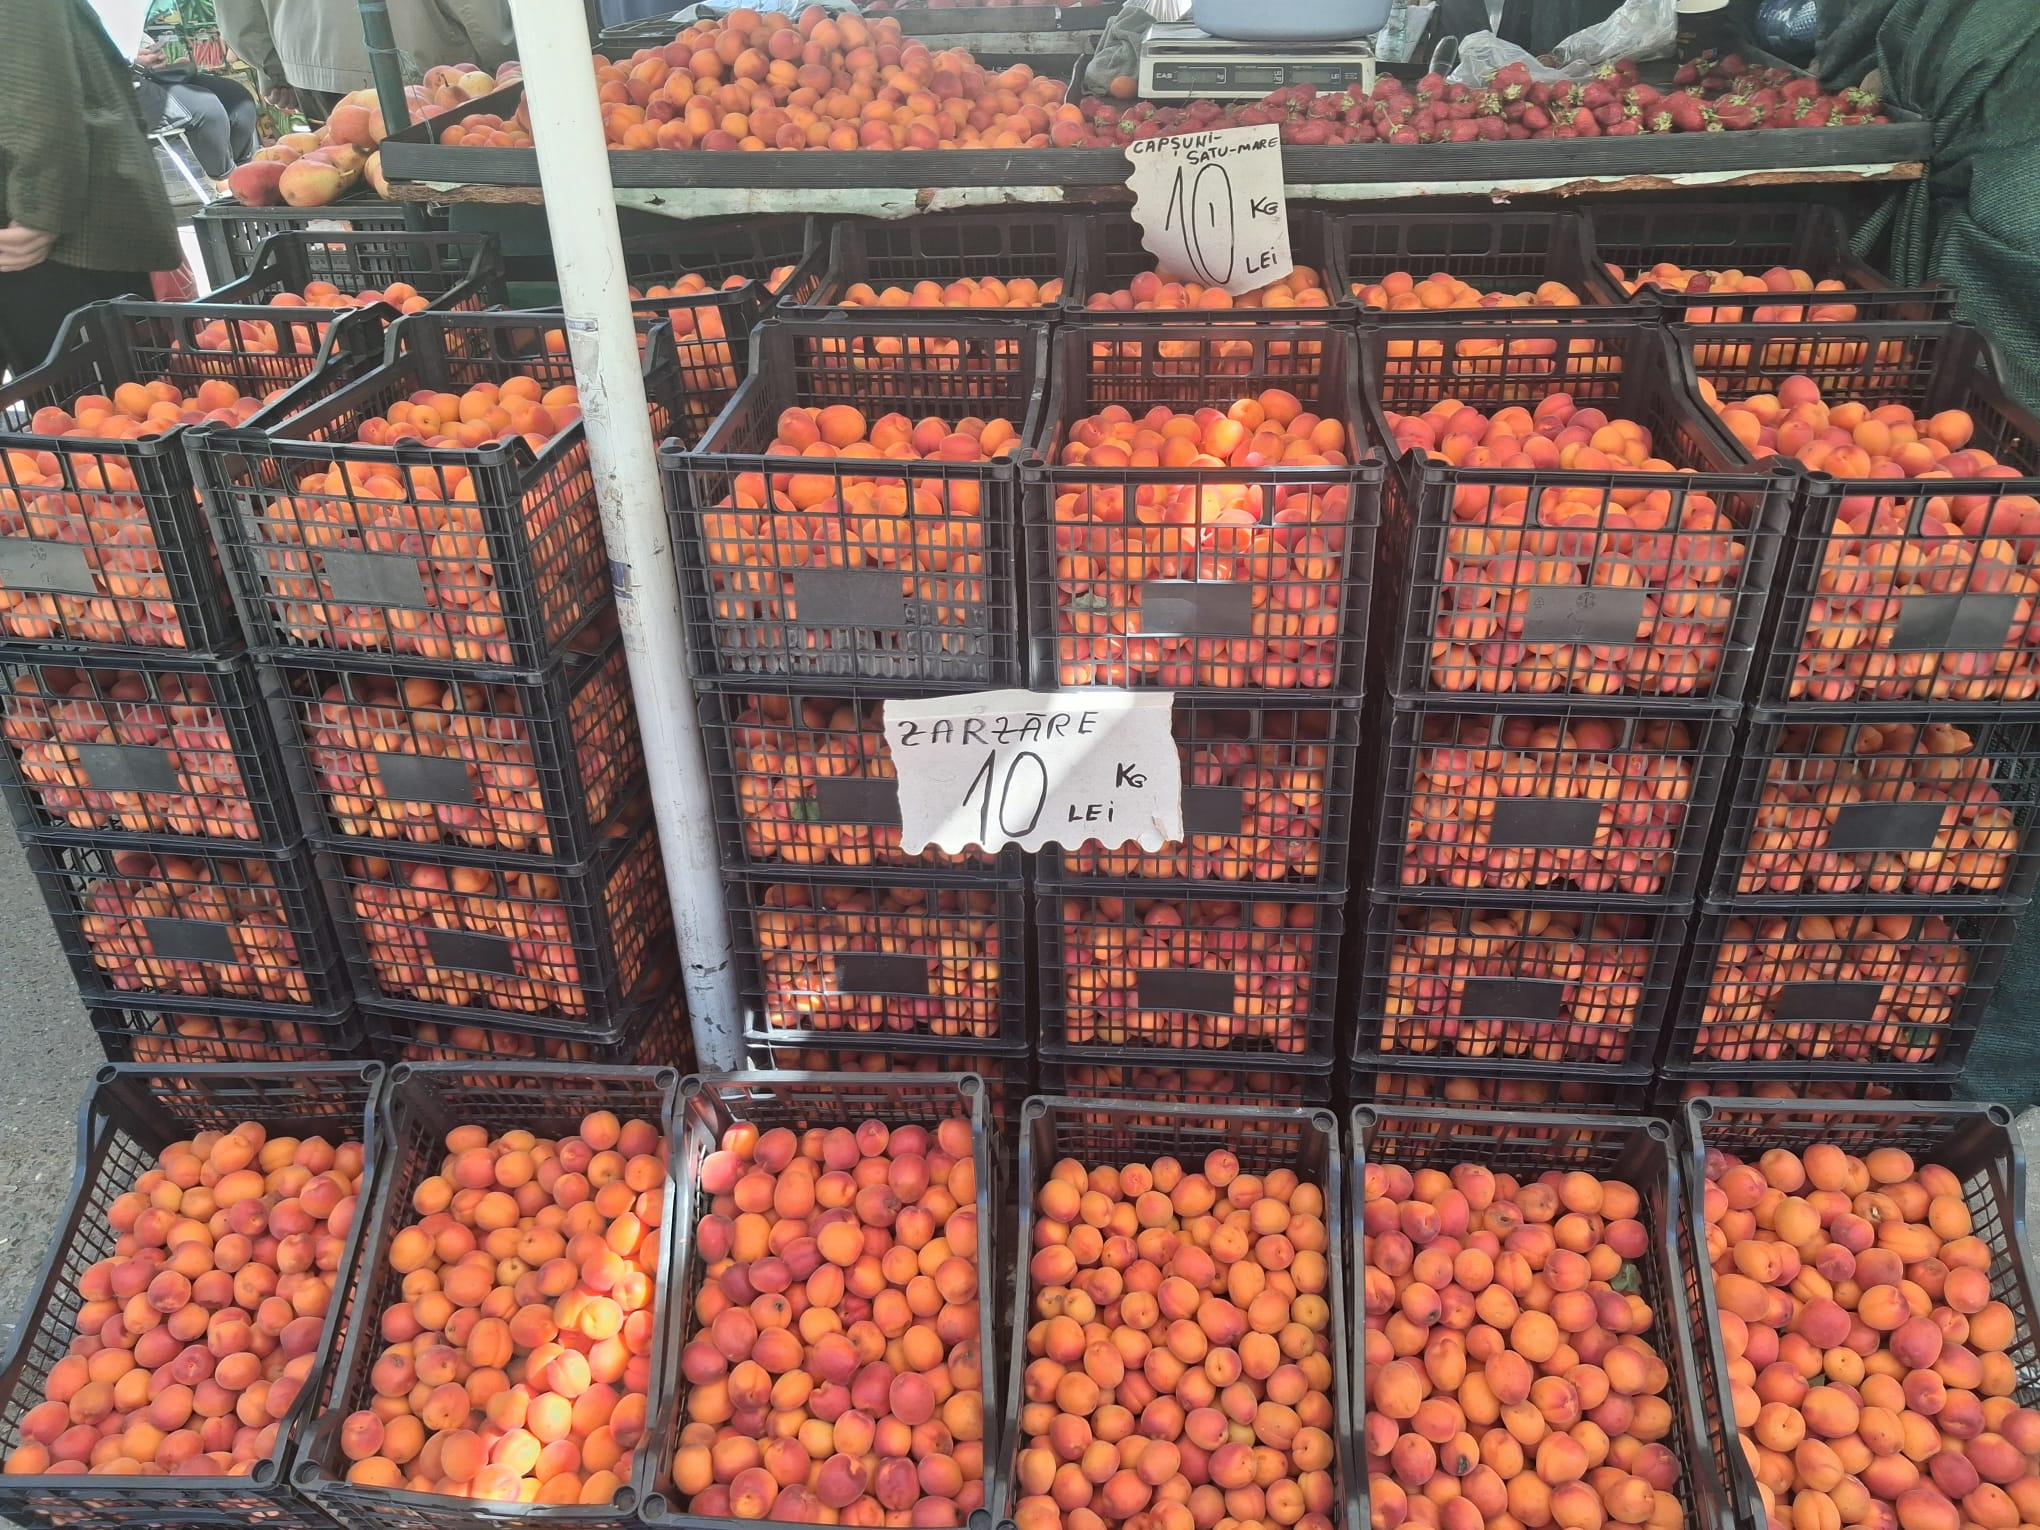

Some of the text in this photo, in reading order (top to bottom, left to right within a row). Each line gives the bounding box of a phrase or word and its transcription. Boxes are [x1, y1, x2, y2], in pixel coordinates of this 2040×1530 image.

[1186, 136, 1279, 165] SATU-MARE
[1165, 163, 1234, 287] 10
[962, 748, 1048, 845] 10
